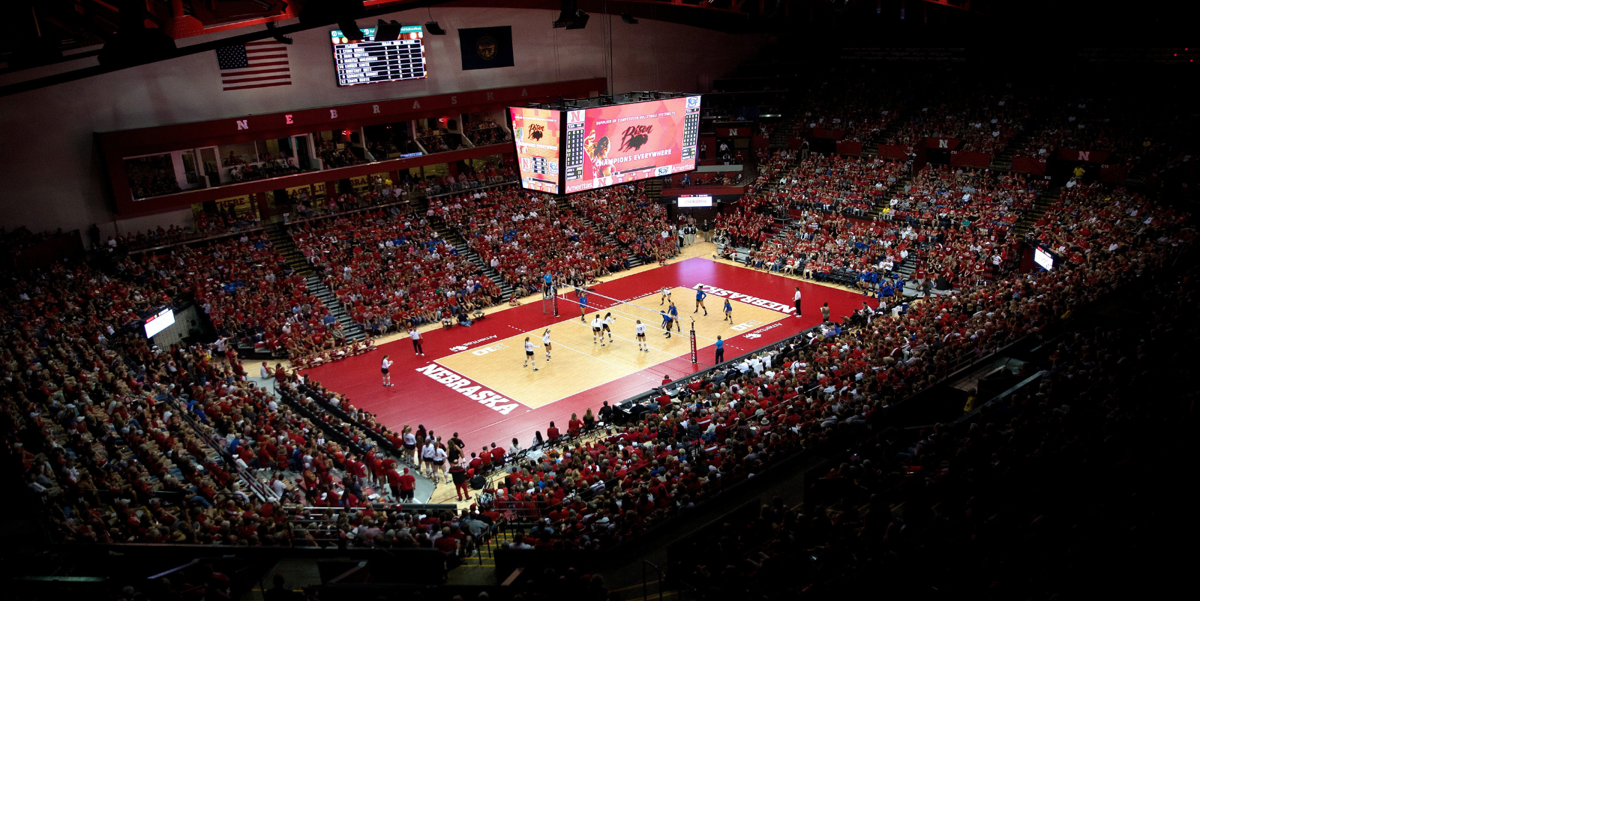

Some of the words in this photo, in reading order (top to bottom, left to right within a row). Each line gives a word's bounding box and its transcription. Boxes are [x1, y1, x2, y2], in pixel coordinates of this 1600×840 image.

[620, 124, 653, 143] Bison
[728, 128, 738, 136] N
[938, 139, 948, 149] N
[595, 155, 632, 167] CHAMPIONS
[633, 148, 672, 161] EVERYWHERE
[1078, 150, 1089, 161] N
[672, 163, 695, 173] Ameritas
[566, 182, 593, 192] Ameritas
[692, 283, 797, 314] NEBRASKA
[416, 363, 520, 415] NEBRASKA
